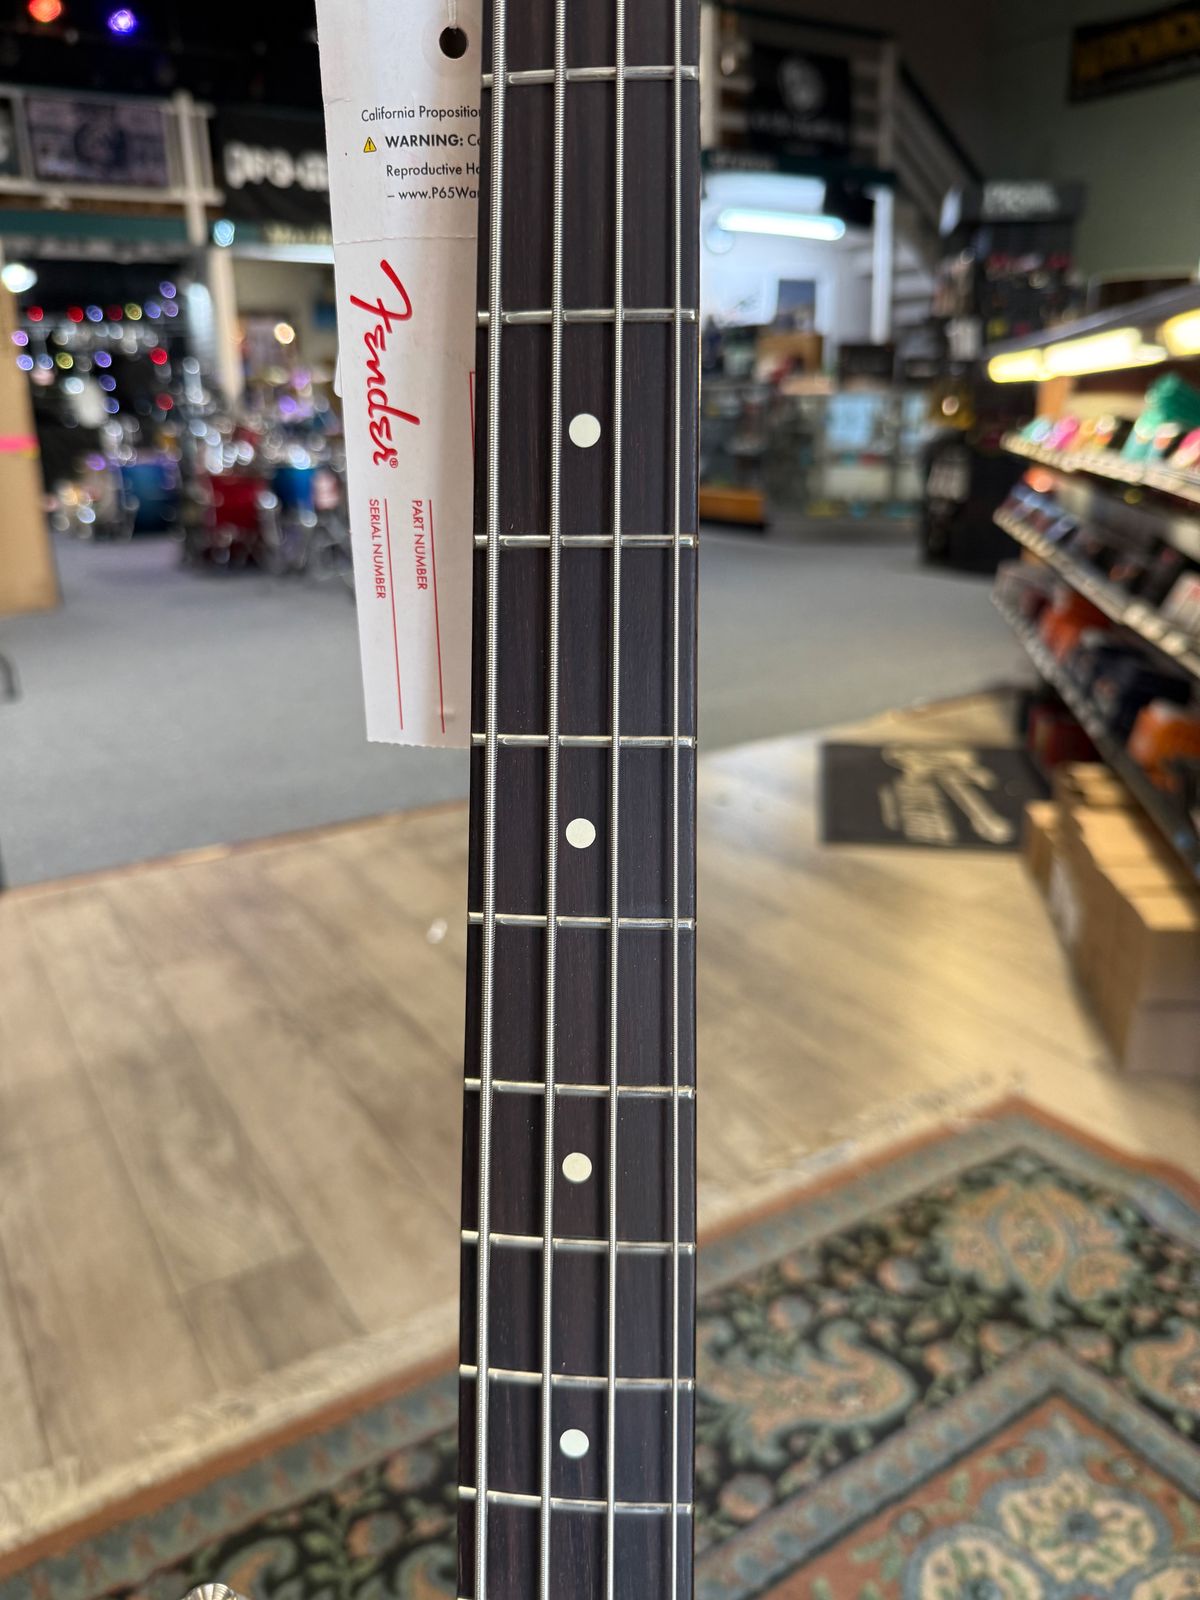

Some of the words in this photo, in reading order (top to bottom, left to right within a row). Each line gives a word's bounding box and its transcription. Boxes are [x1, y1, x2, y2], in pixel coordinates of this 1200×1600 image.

[361, 106, 415, 122] California
[384, 134, 464, 148] WARNING:
[386, 162, 462, 179] Reproductive
[369, 499, 381, 538] SERIAL
[412, 500, 425, 531] PART
[373, 543, 386, 599] NUMBER
[414, 534, 428, 590] NUMBER
